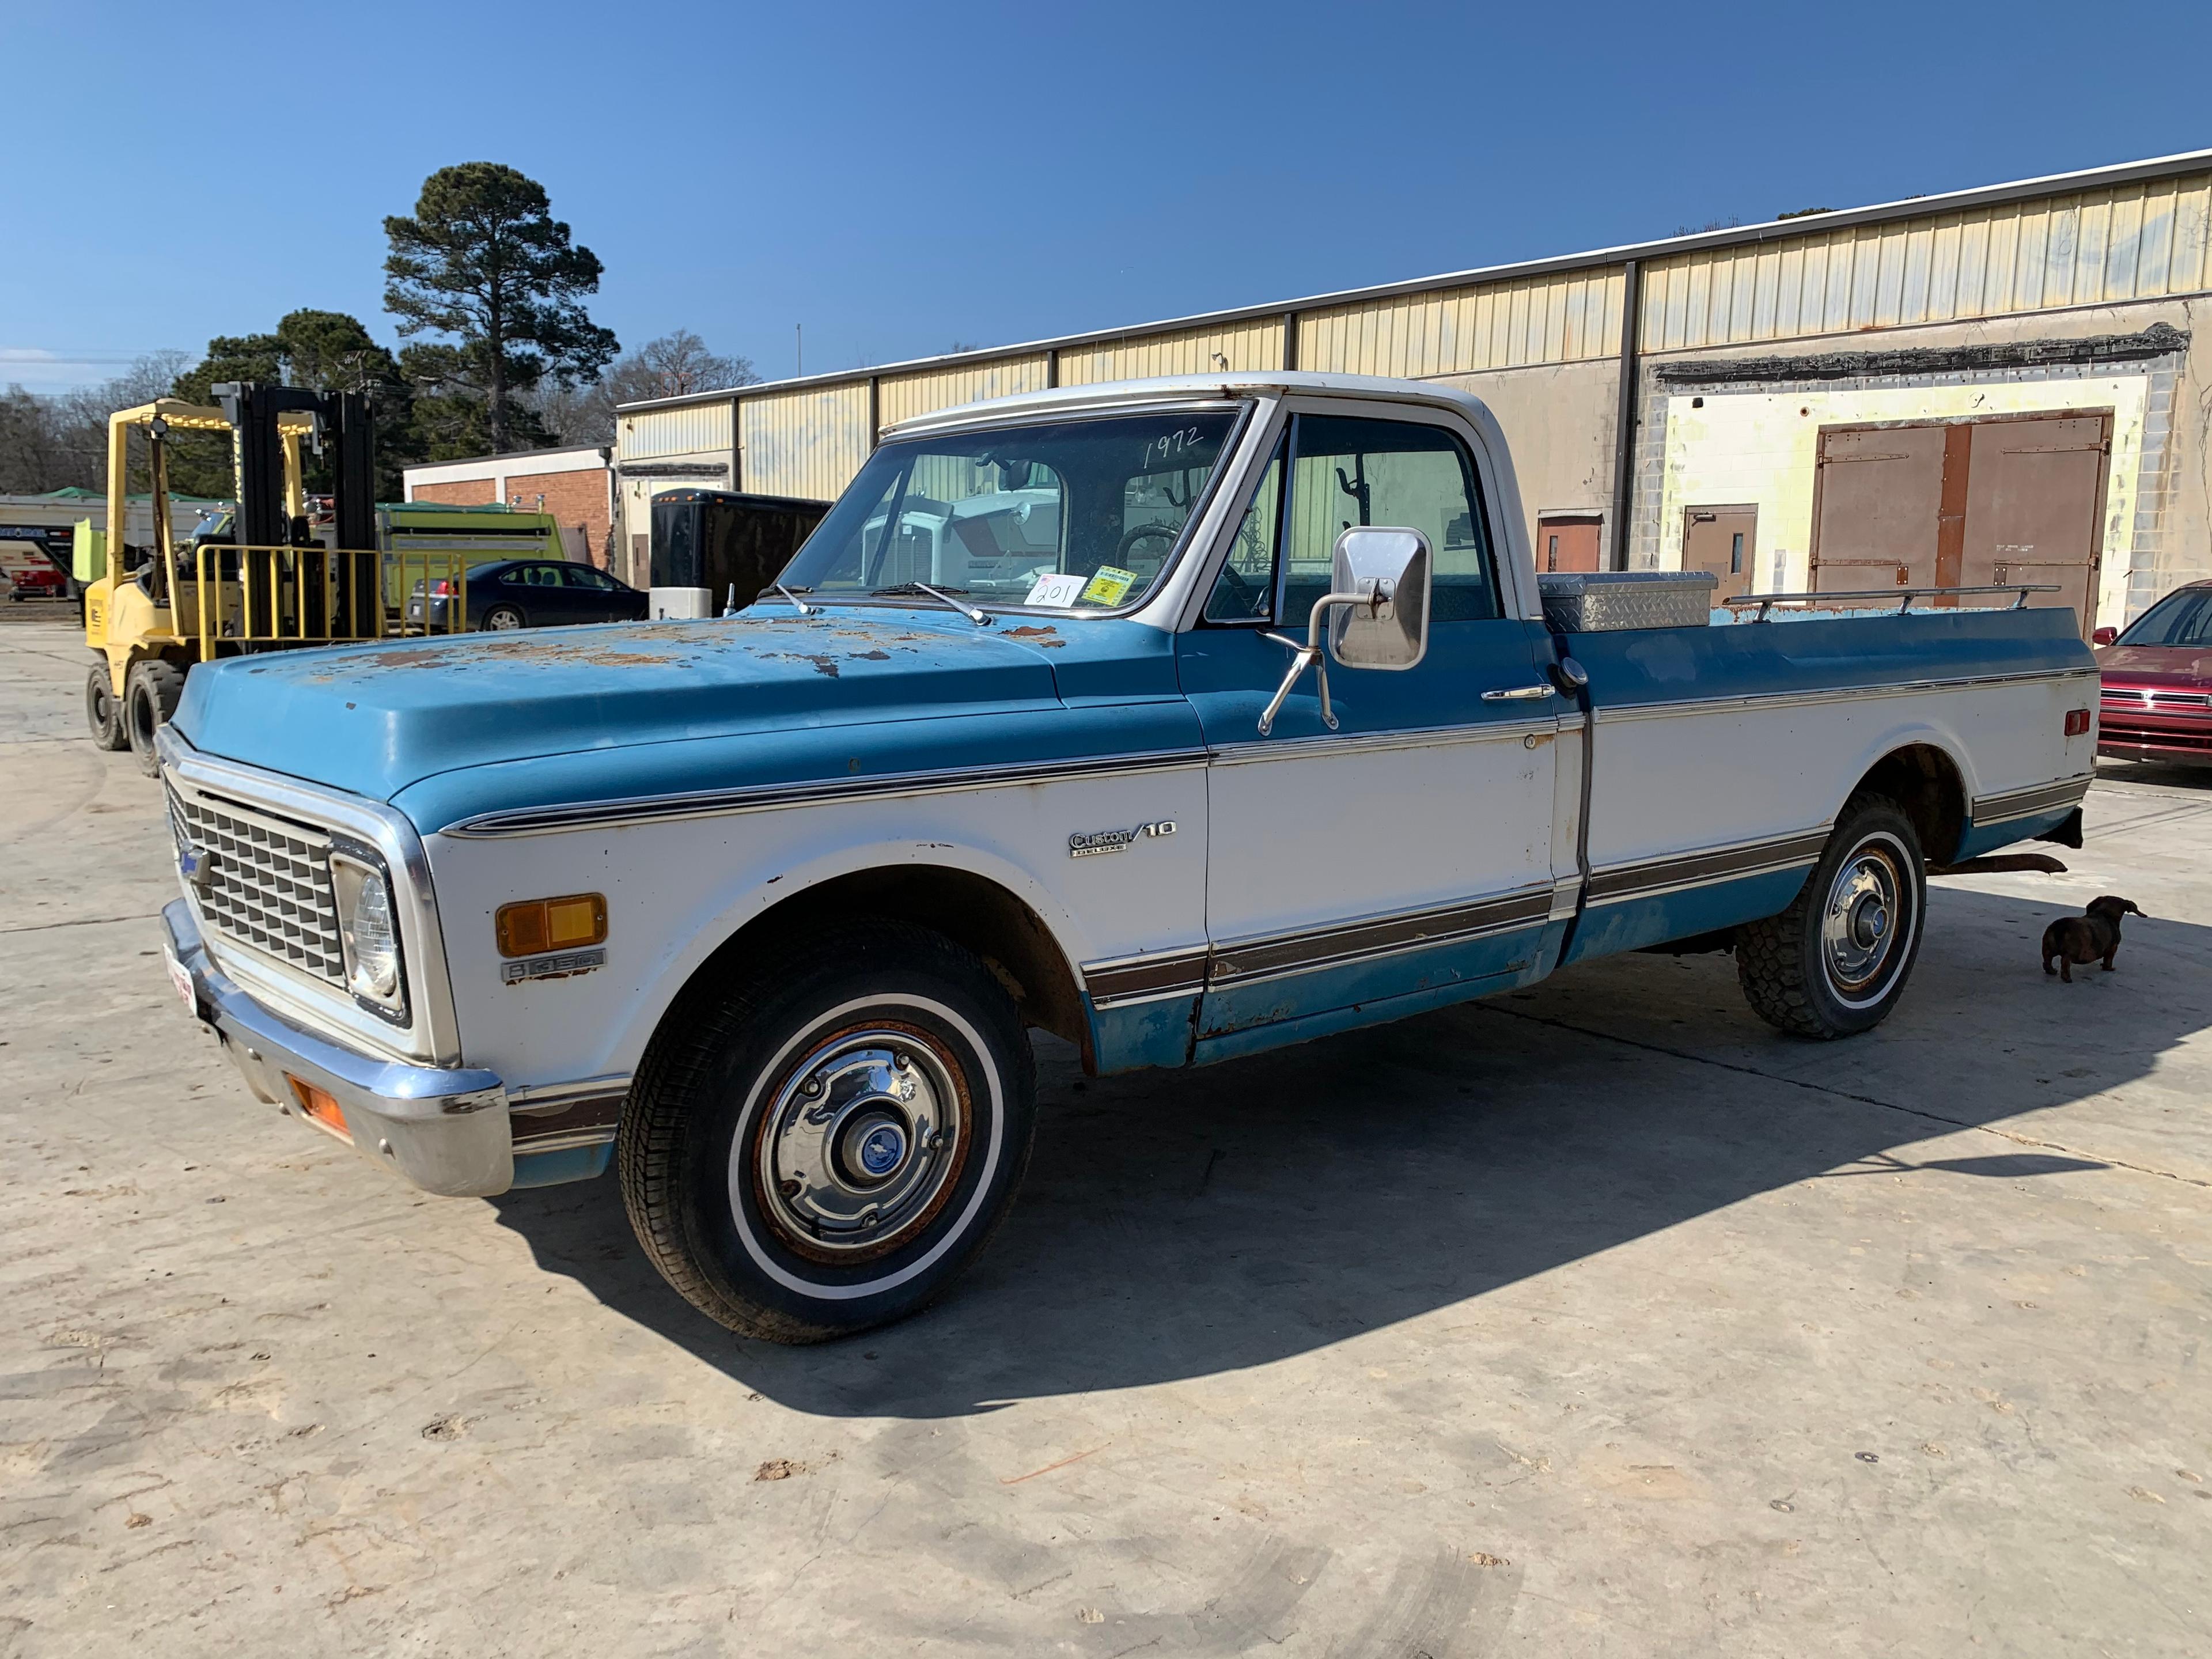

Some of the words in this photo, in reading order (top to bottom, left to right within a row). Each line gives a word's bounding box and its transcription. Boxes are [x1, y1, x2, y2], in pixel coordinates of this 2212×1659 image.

[1143, 426, 1205, 469] 1972
[1036, 585, 1071, 604] 201
[1075, 844, 1125, 855] DELUXE
